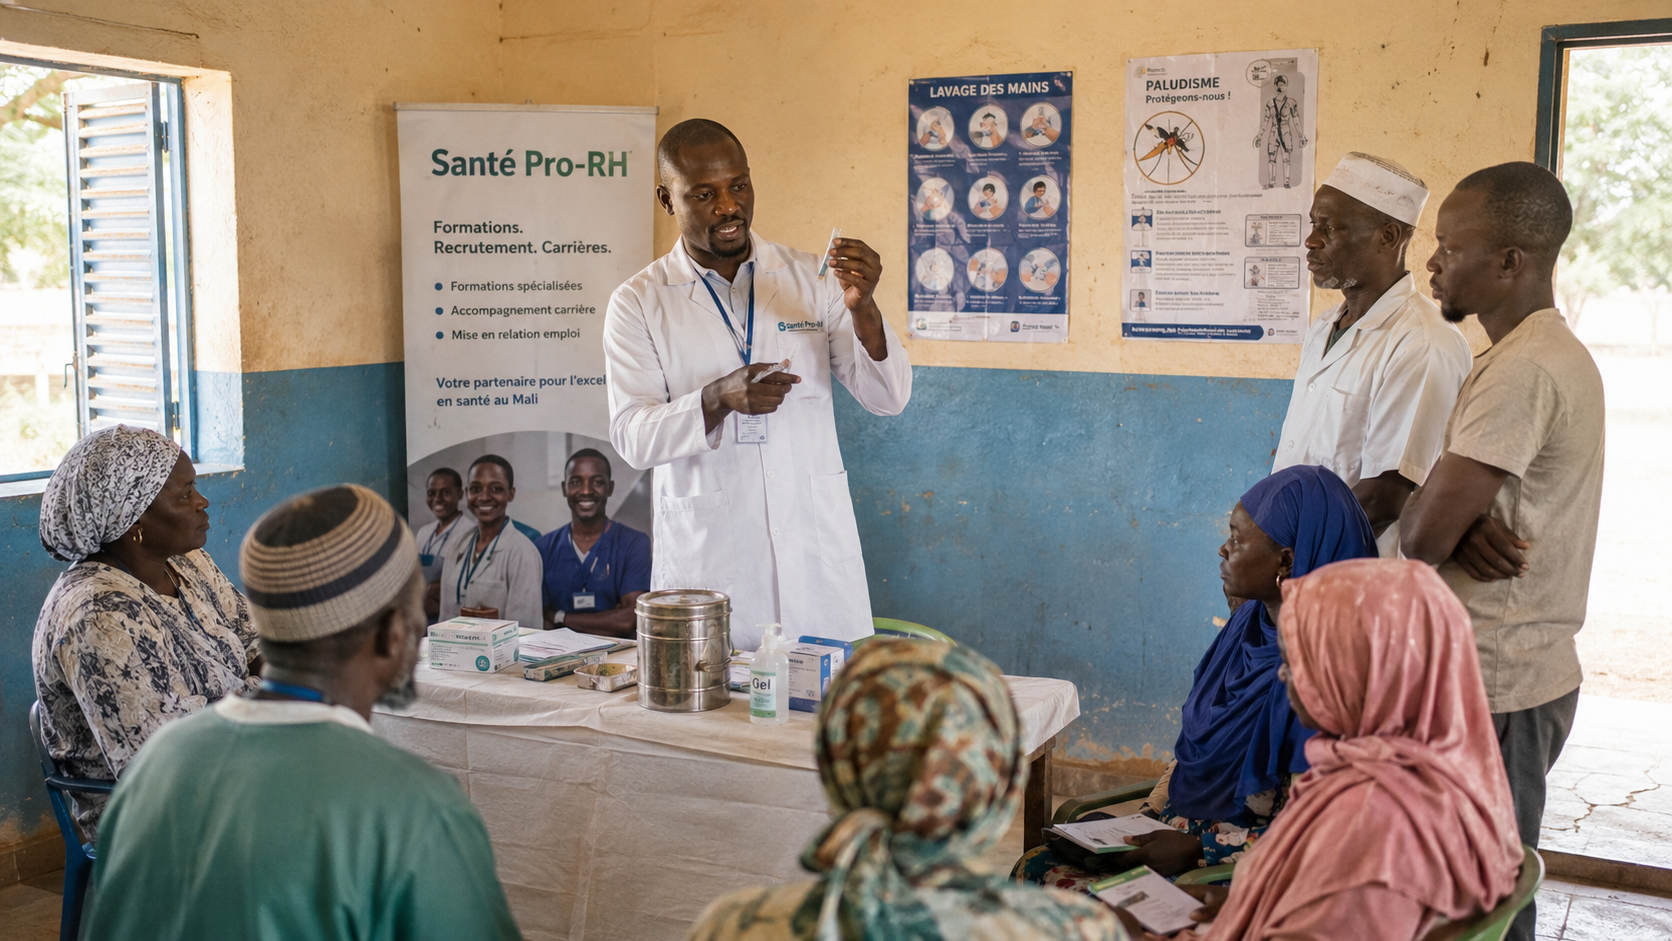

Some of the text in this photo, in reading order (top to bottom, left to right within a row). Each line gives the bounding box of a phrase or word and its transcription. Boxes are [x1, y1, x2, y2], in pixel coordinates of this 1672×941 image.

[929, 81, 1050, 98] LAVAGE DES MAINS
[1145, 77, 1220, 92] PALUDISME
[1145, 93, 1226, 105] Protégeons-nous
[431, 148, 628, 178] Santé Pro-RH
[433, 220, 524, 234] Formations.
[433, 240, 612, 254] Recrutement. Carrières.
[450, 280, 583, 294] Formations spécialisées
[450, 303, 596, 318] Accompagnement carrière
[451, 328, 581, 342] Mise en relation emploi
[435, 374, 606, 390] Votre partenaire pour l'excel
[436, 393, 539, 407] en santé au Mali
[752, 677, 771, 691] Gel
